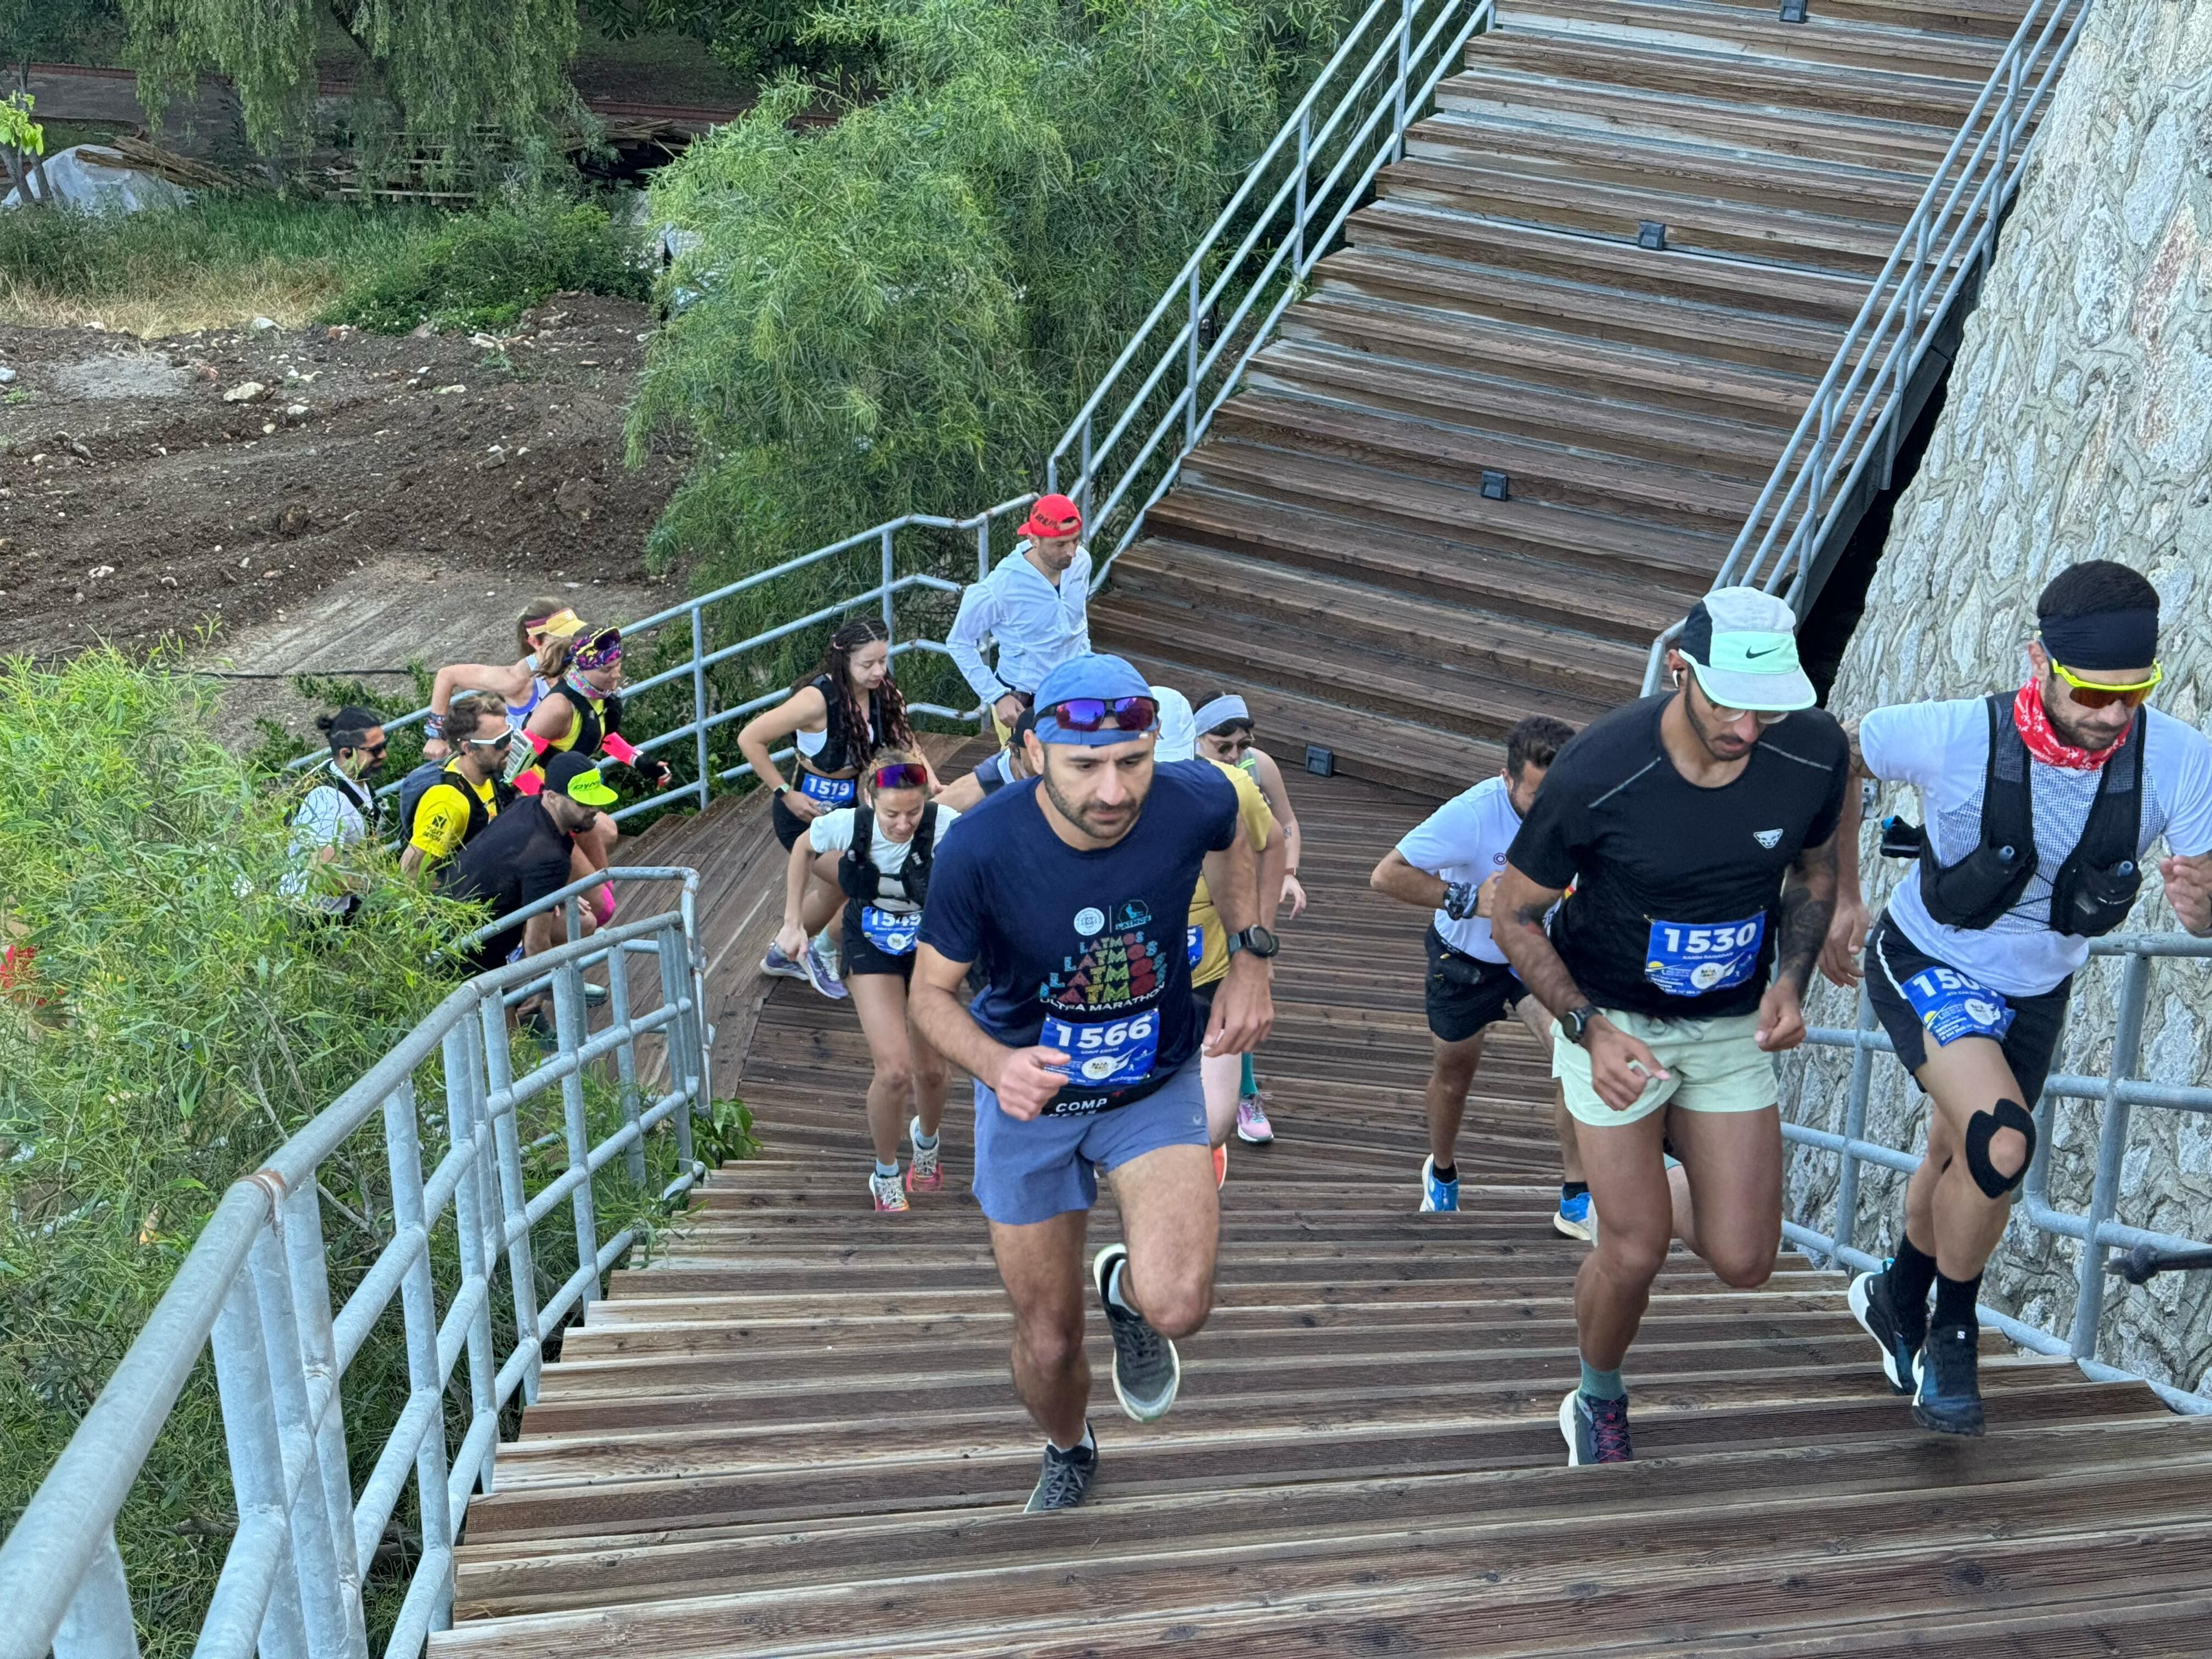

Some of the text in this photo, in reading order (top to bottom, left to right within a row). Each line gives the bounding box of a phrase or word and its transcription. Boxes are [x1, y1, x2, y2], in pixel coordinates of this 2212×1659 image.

[809, 777, 849, 796] 1519
[1664, 923, 1756, 953] 1530
[1040, 981, 1165, 1012] ULTRA MARATHON
[1056, 1017, 1152, 1049] 1566
[1056, 1098, 1107, 1113] COMP
